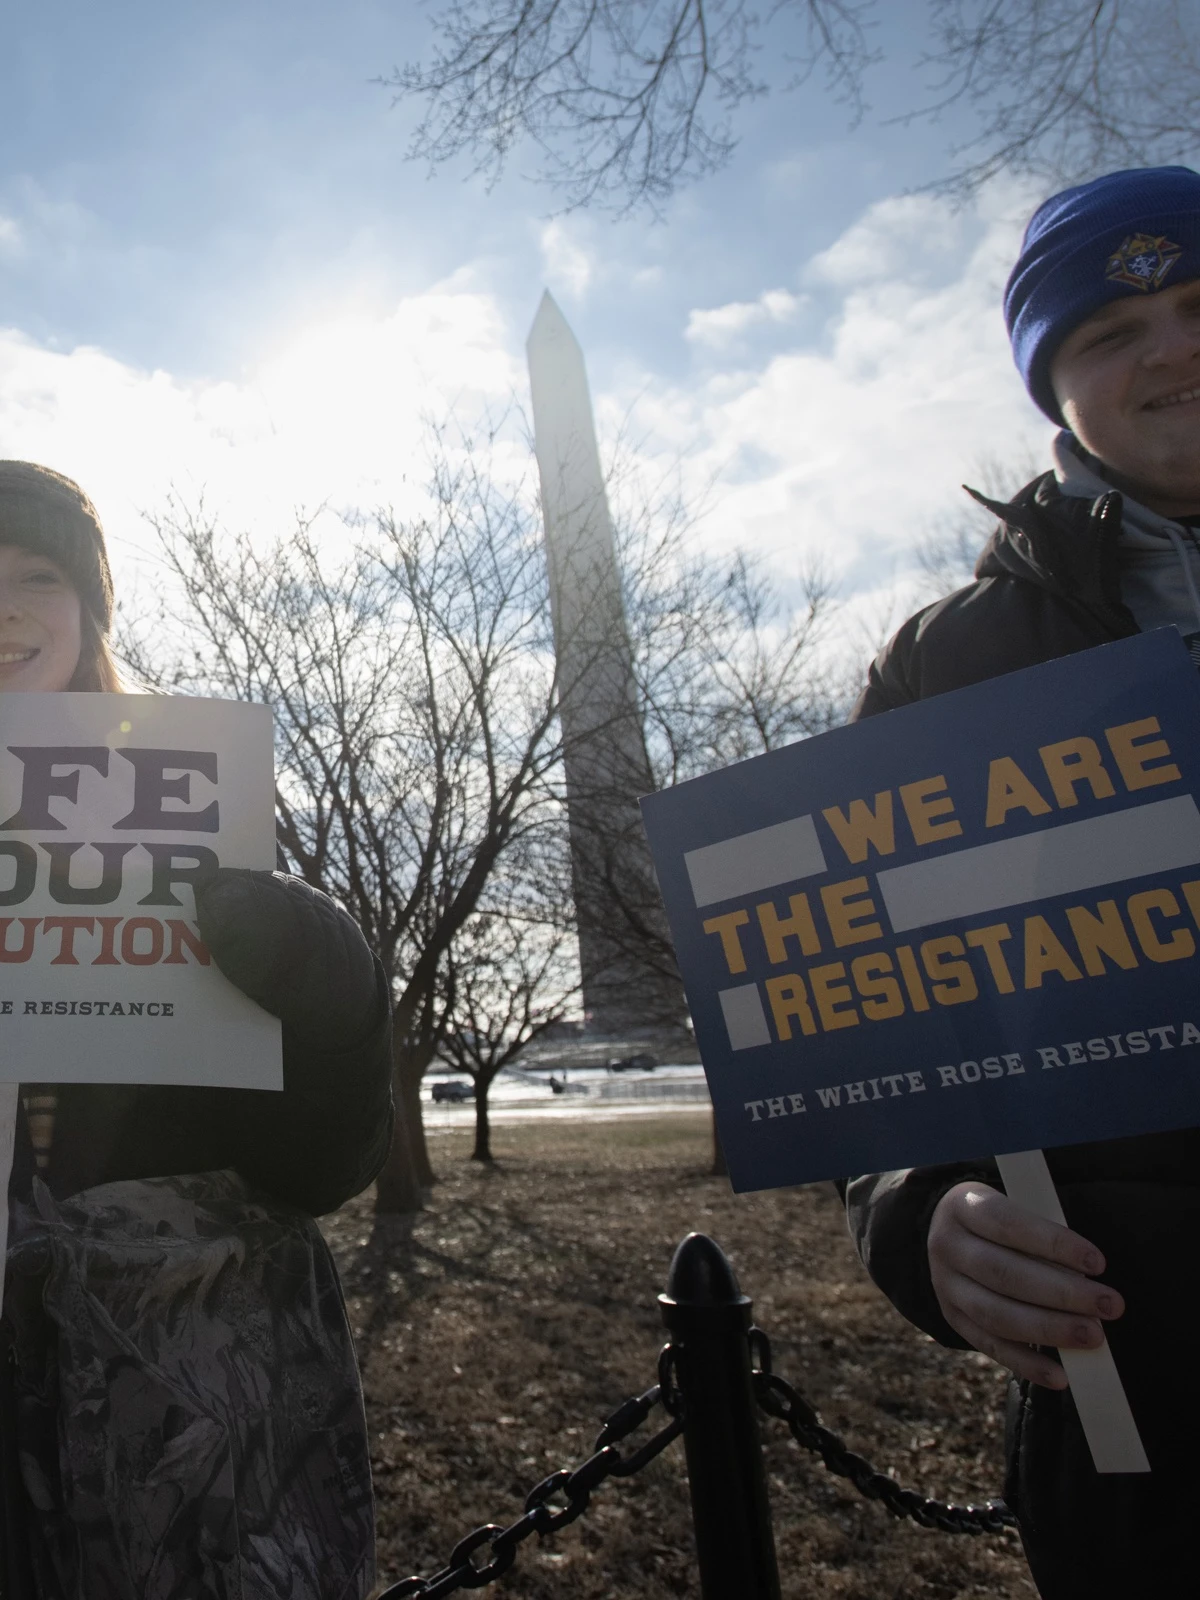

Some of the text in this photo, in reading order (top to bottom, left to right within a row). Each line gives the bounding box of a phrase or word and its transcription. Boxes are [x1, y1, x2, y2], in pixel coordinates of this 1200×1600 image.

[822, 716, 1182, 865] WE ARE
[703, 876, 883, 975] THE
[23, 1001, 174, 1017] RESISTANCE
[744, 1093, 806, 1121] THE
[815, 1071, 926, 1109] WHITE
[936, 1053, 1026, 1087] ROSE
